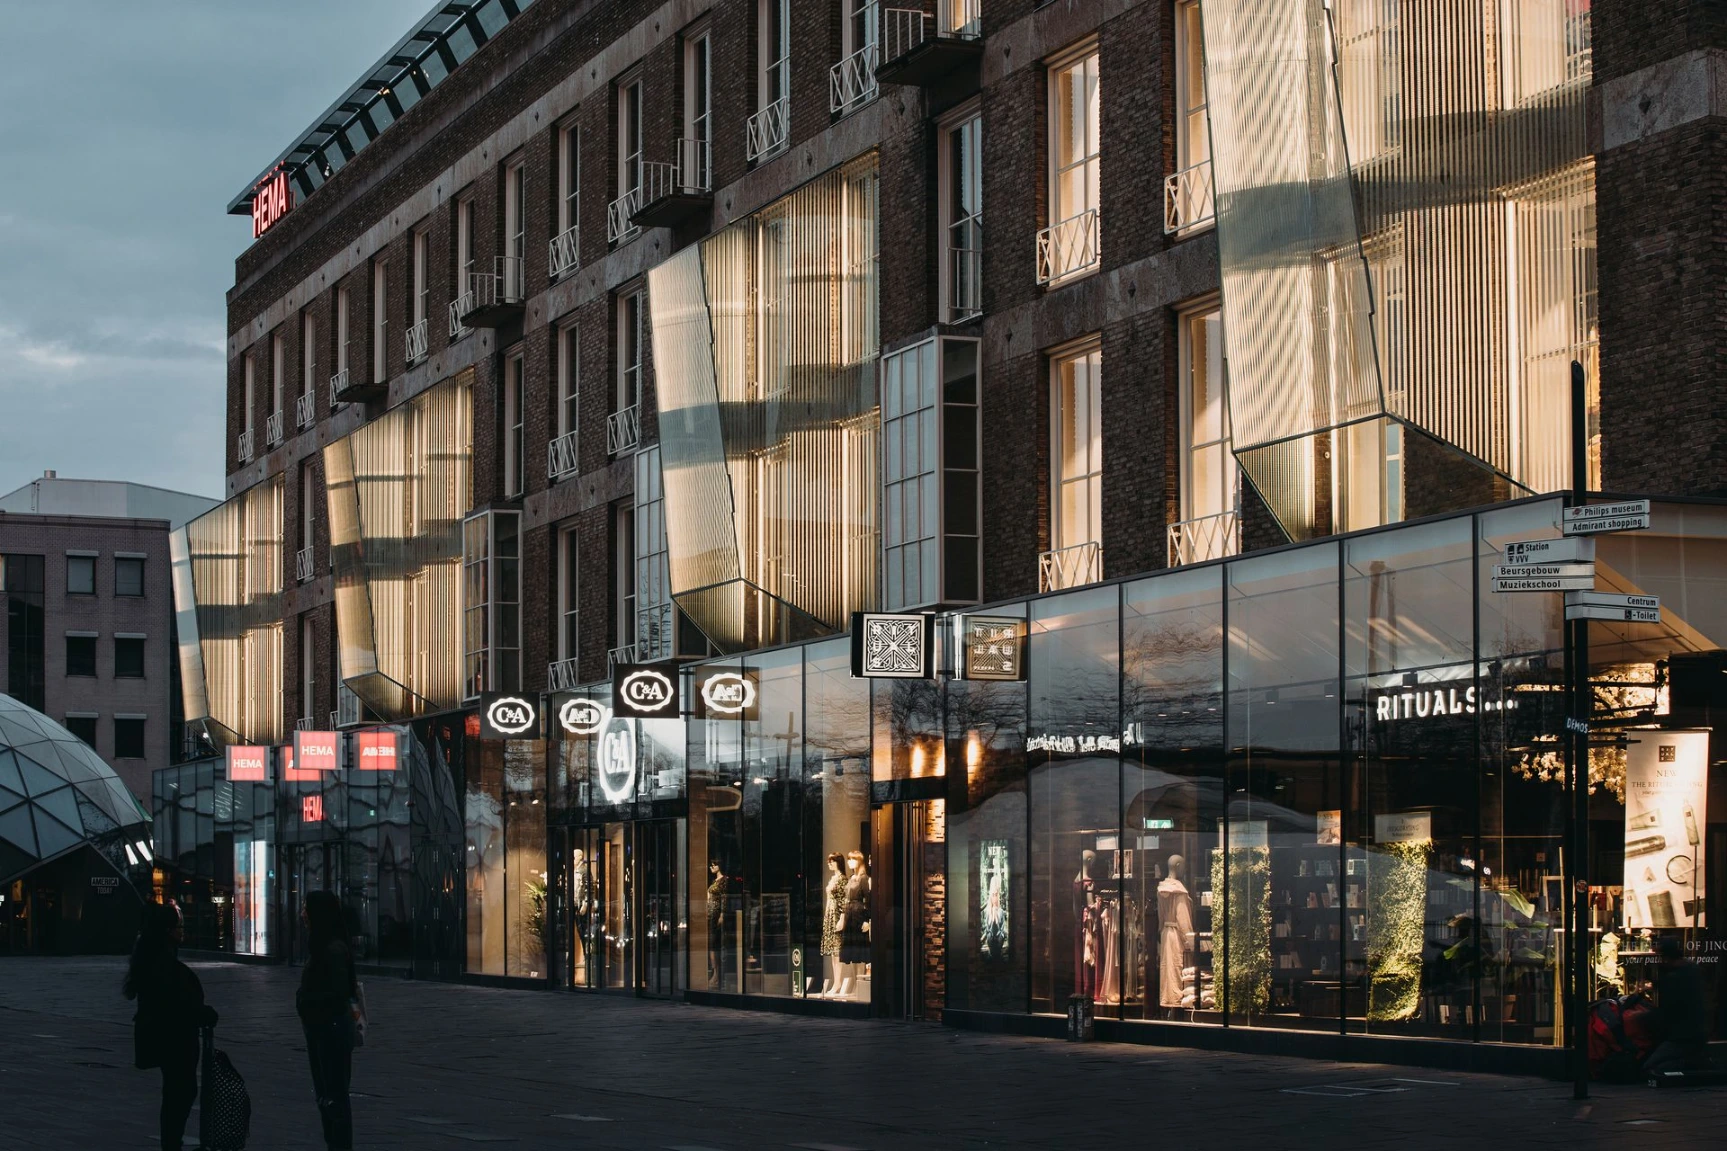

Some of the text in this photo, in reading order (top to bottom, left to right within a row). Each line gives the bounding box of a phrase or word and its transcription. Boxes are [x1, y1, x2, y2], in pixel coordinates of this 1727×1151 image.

[253, 172, 286, 238] HEMA
[1584, 504, 1643, 516] Philips museum
[1572, 518, 1642, 531] Admirant shopping
[1525, 543, 1549, 552] Station
[1500, 567, 1560, 576] Beursgebouw
[1500, 580, 1560, 589] Muziekschool
[1627, 597, 1656, 606] Centrum
[630, 681, 664, 700] C&A
[496, 707, 527, 723] C&A
[302, 746, 334, 755] HEMA
[233, 759, 263, 768] HEMA
[92, 878, 118, 886] AMERICA
[1686, 941, 1701, 951] OF
[1696, 955, 1719, 964] peace
